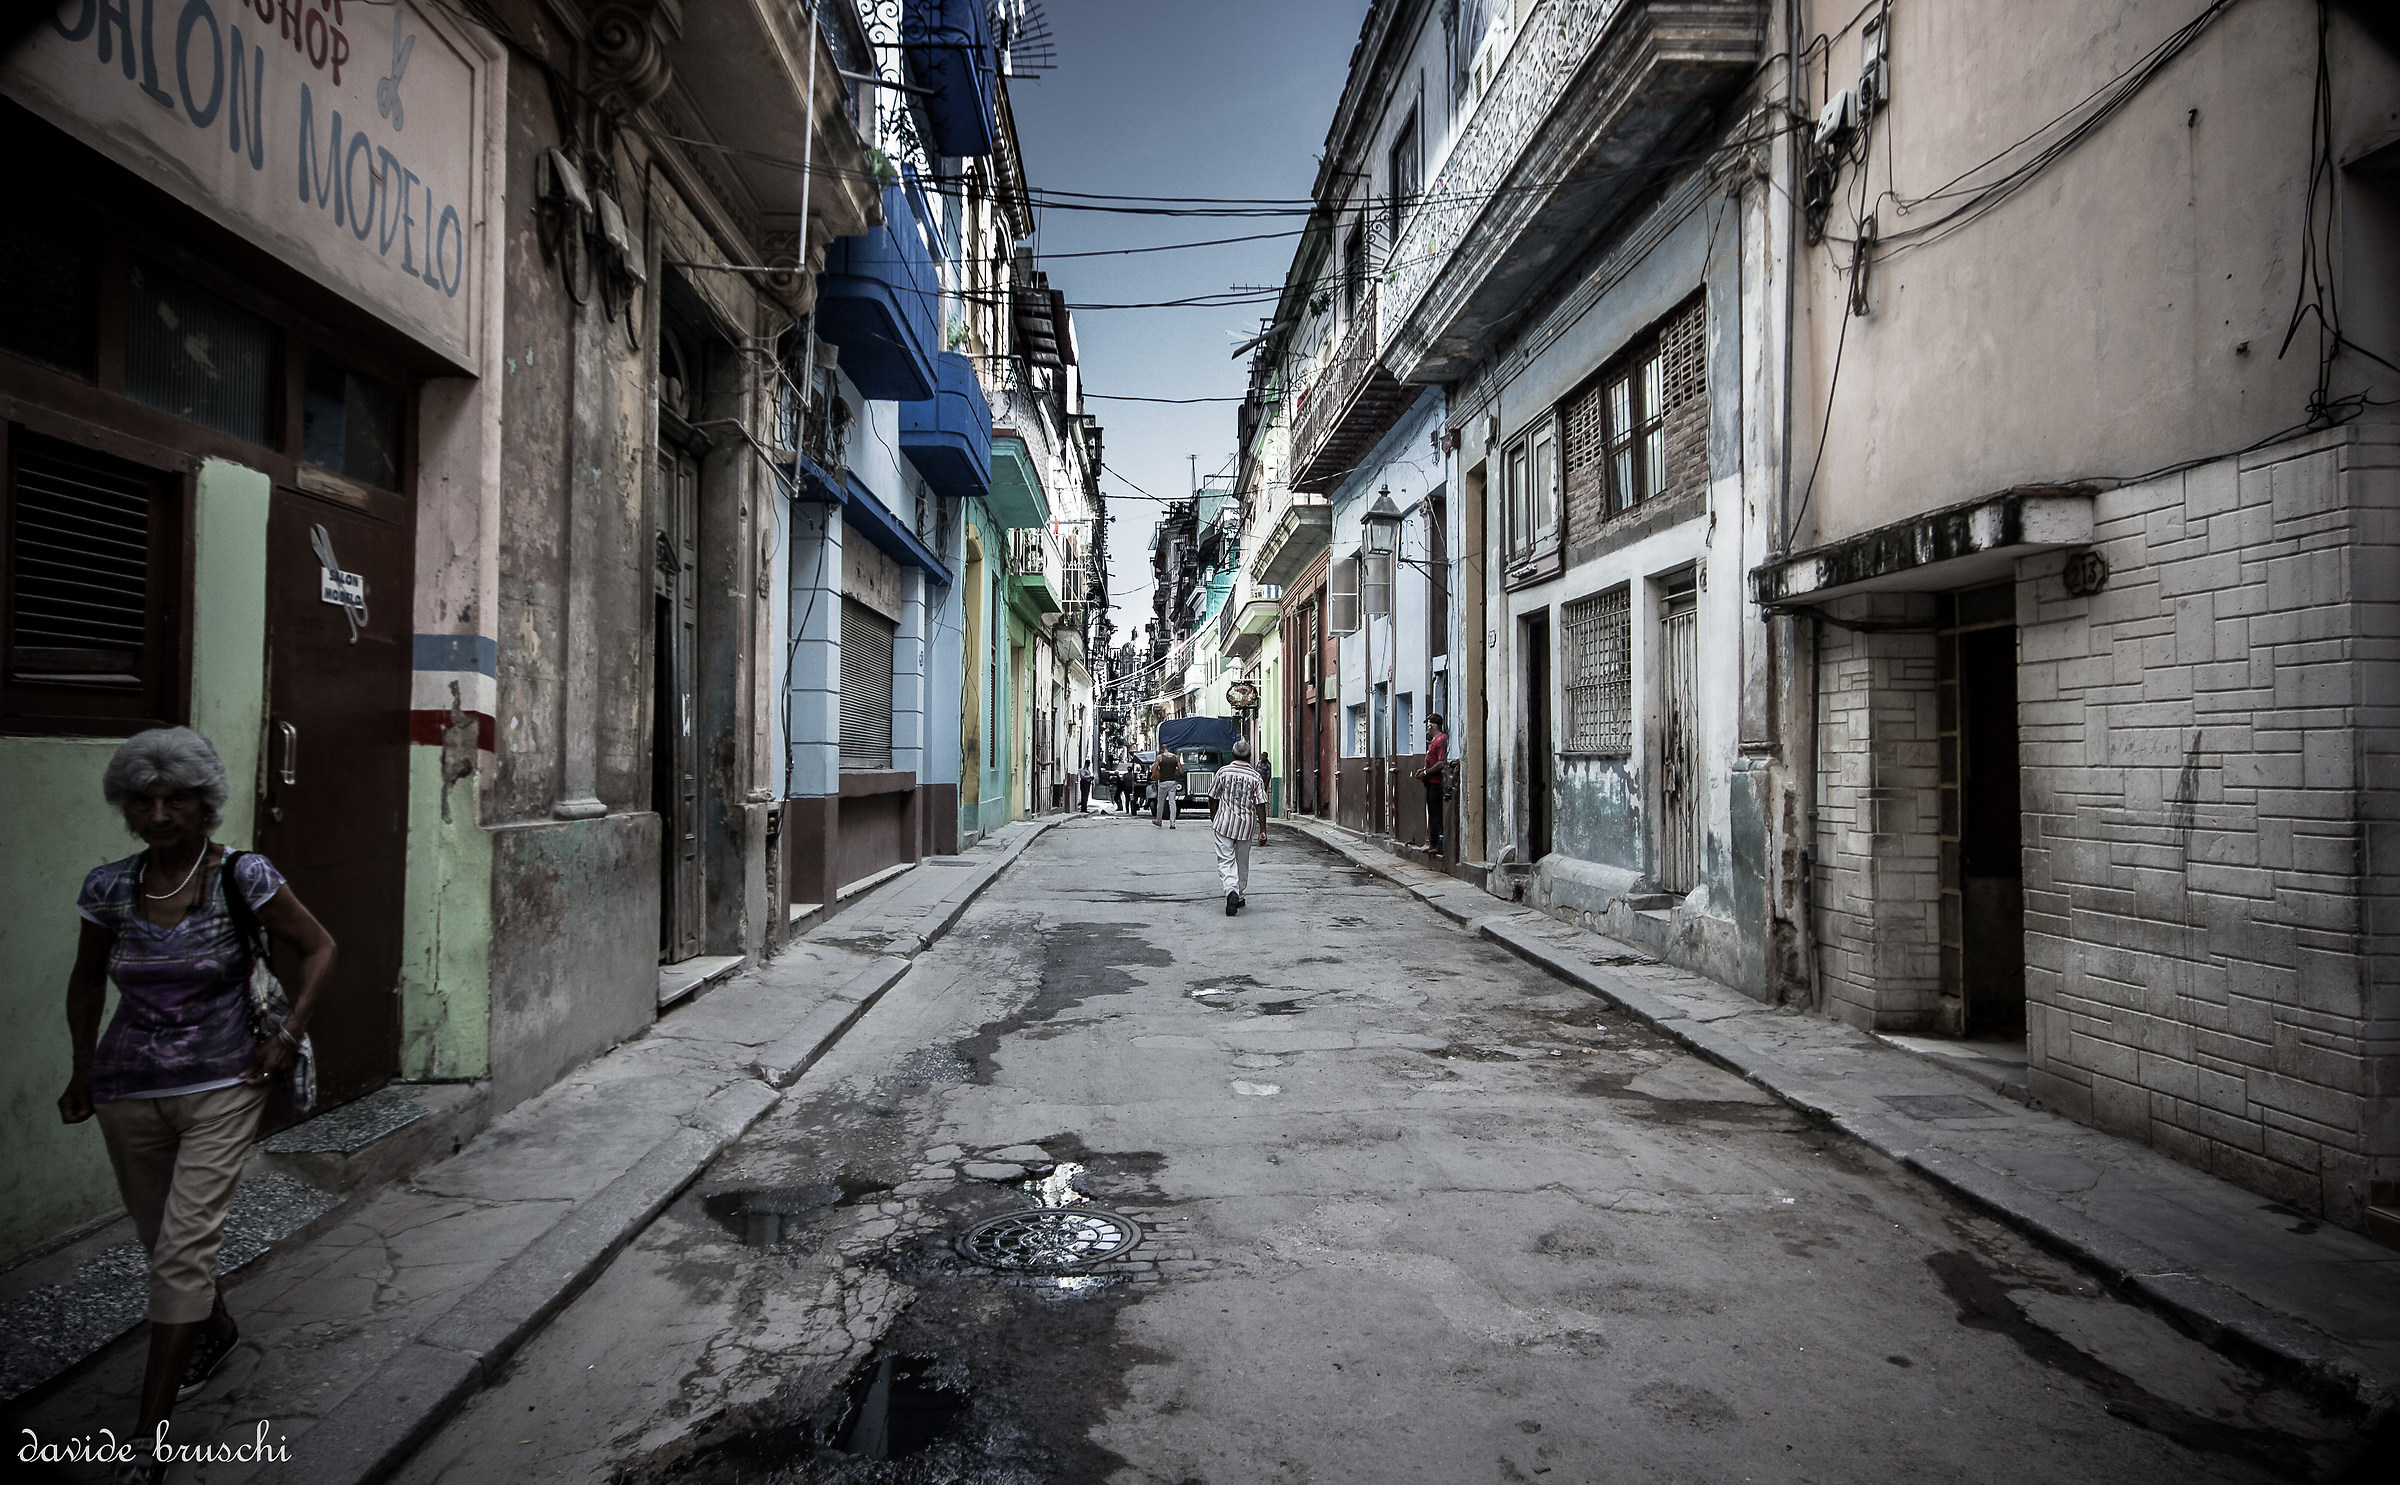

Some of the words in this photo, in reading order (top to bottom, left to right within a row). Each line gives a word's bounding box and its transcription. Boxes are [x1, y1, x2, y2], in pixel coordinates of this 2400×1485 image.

[299, 82, 463, 298] MODELO
[329, 569, 359, 587] SALON
[325, 588, 362, 606] MODELO
